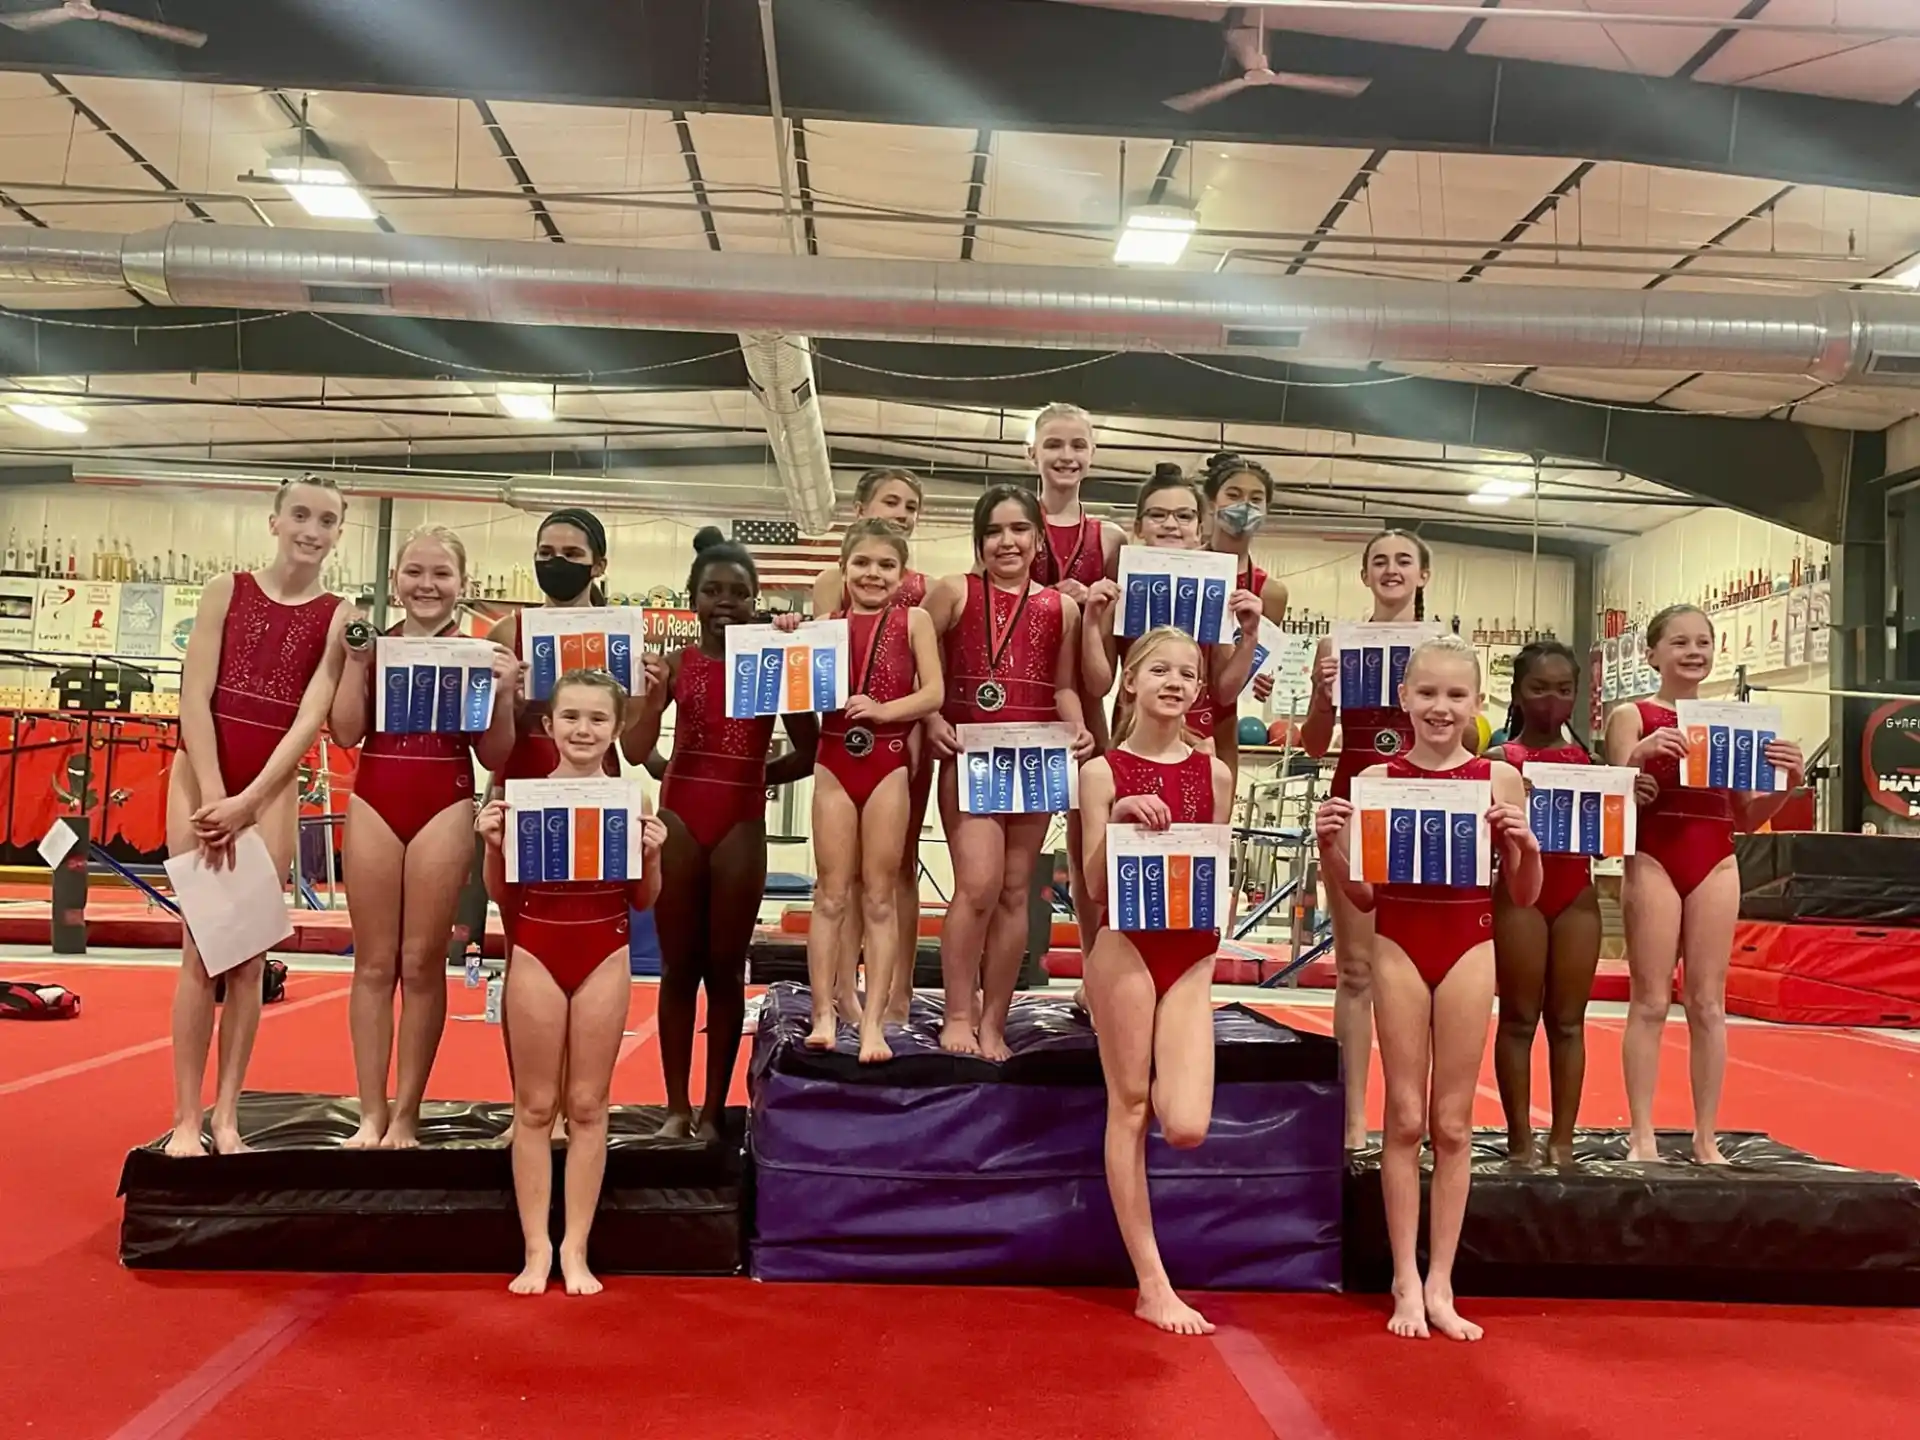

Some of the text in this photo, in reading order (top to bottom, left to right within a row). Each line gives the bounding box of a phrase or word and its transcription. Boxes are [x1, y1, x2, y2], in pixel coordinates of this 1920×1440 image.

[651, 613, 665, 636] To
[667, 613, 701, 637] Reach
[1885, 718, 1920, 730] GYMF
